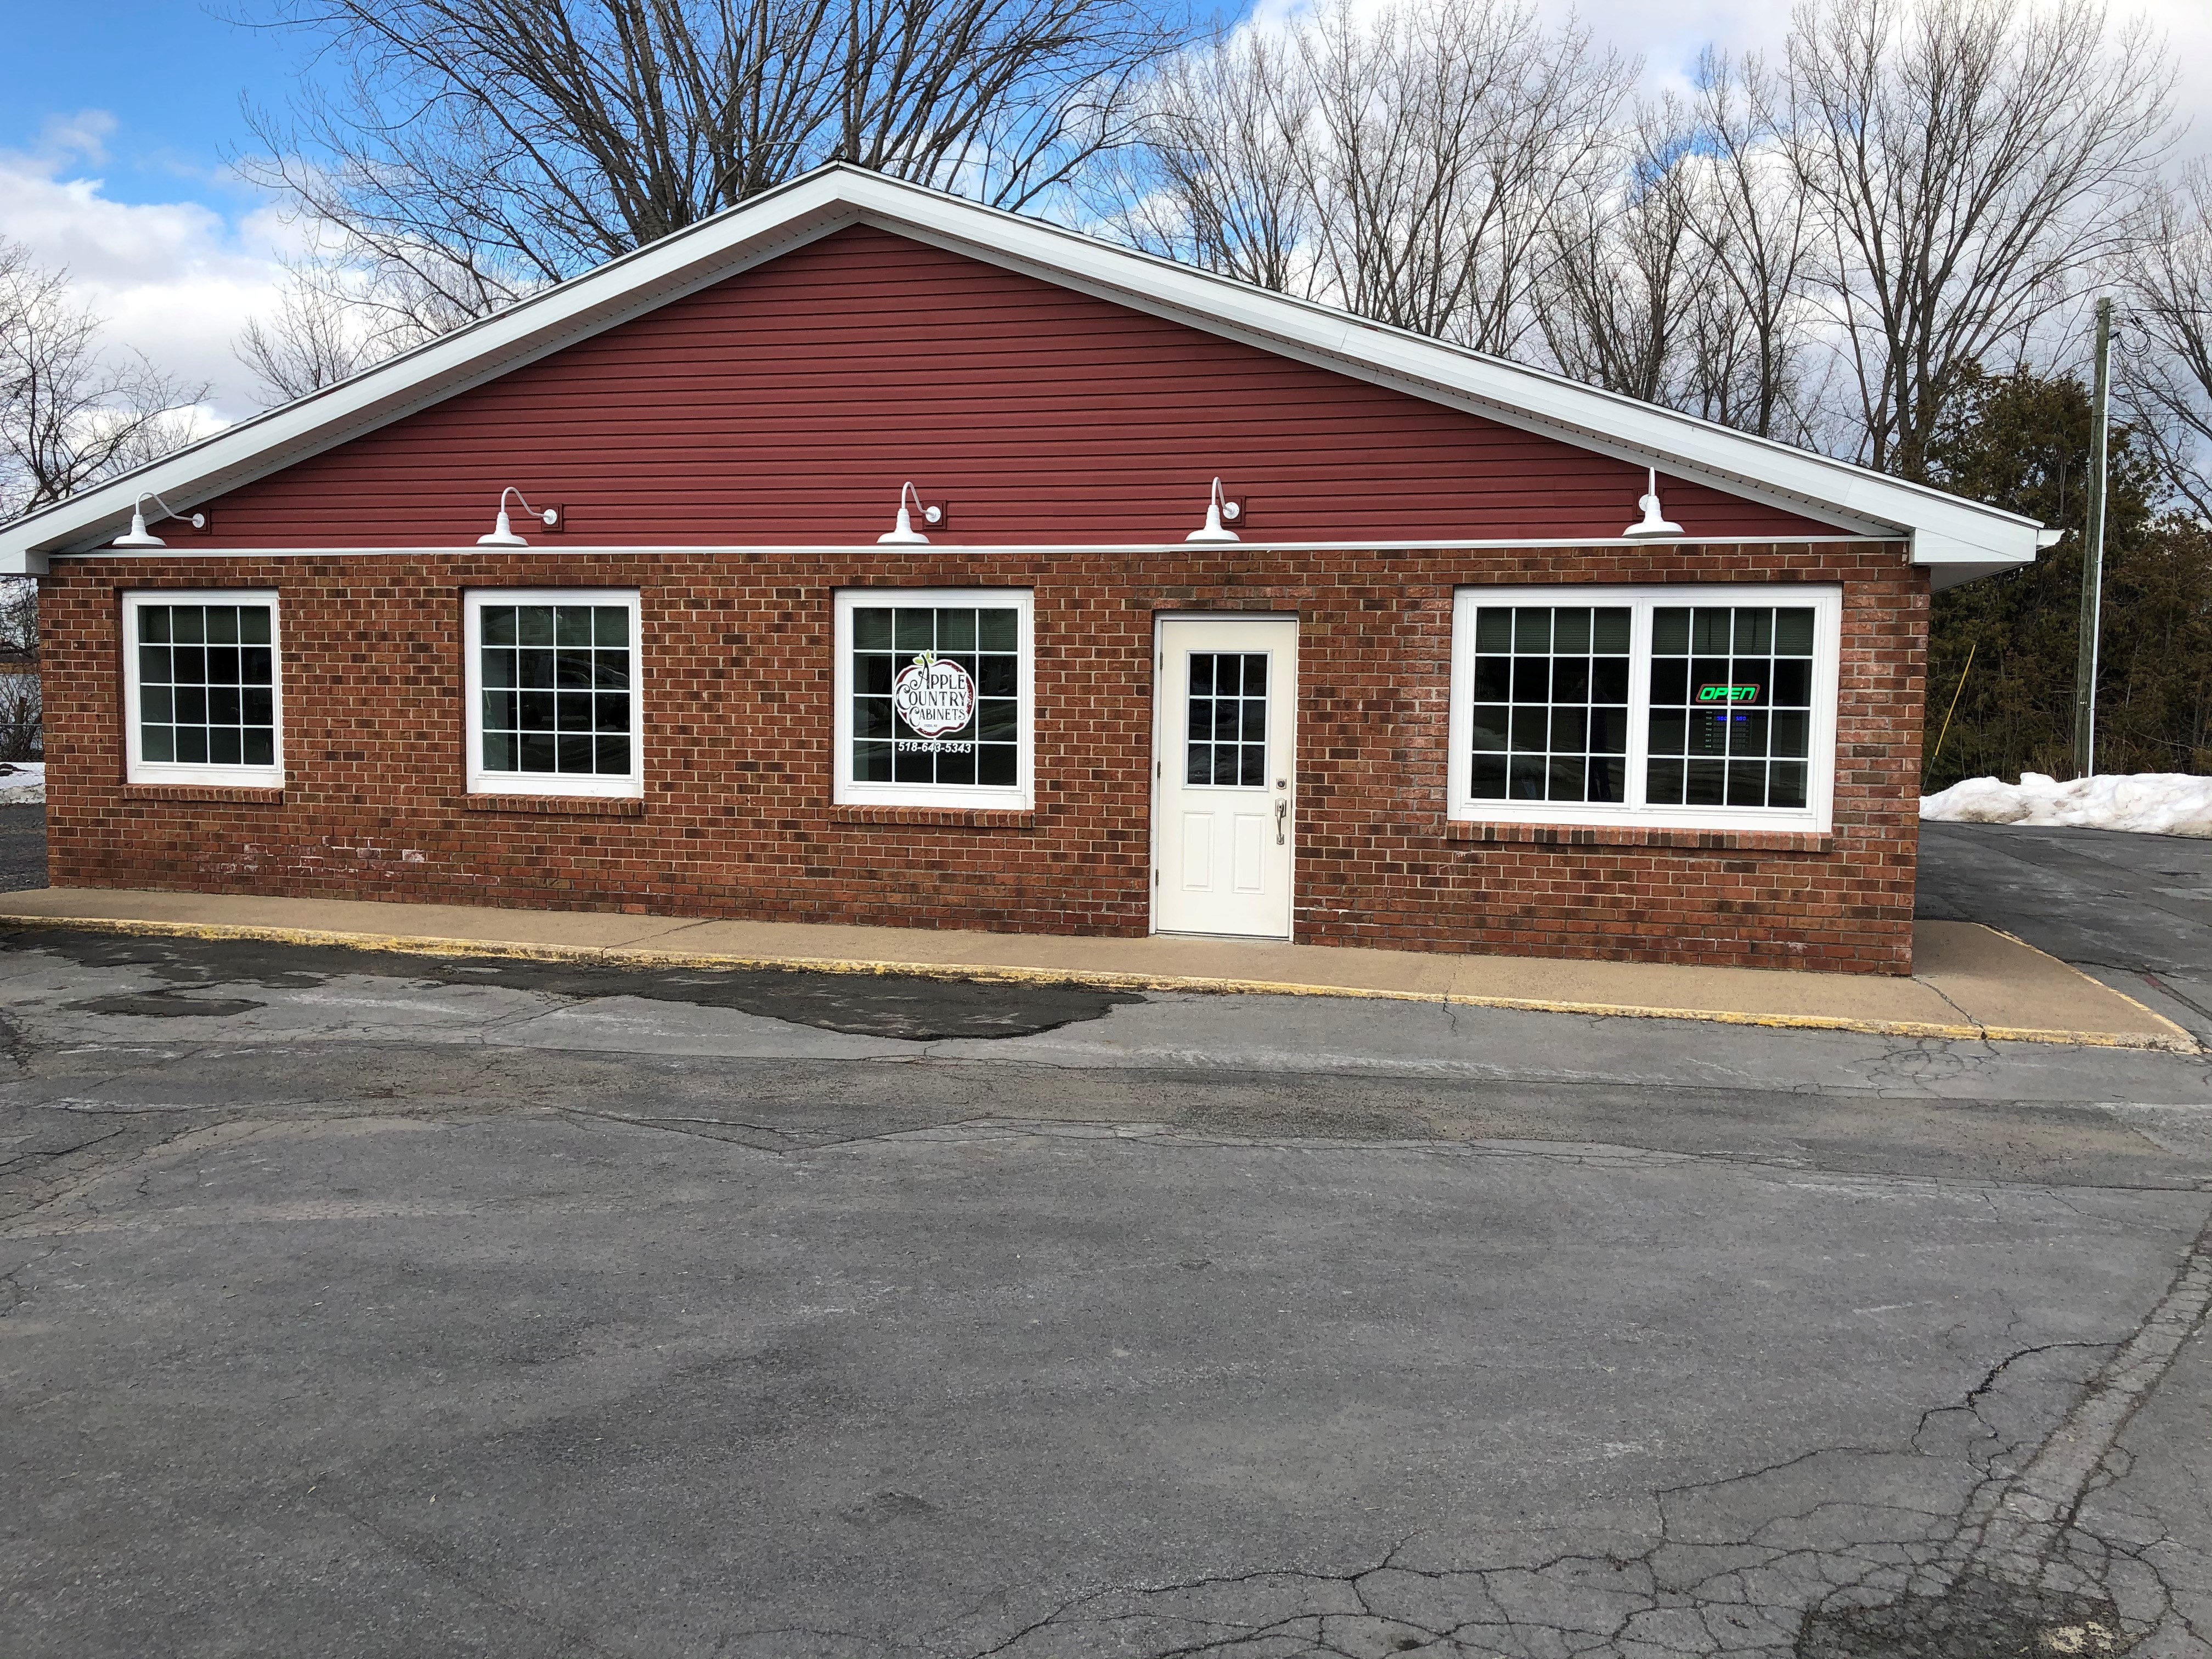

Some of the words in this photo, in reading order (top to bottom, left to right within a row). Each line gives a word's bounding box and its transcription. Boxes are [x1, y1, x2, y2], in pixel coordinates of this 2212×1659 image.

[910, 660, 965, 690] APPLE
[896, 684, 967, 710] COUNTRY
[1700, 687, 1756, 699] OPEN
[909, 707, 966, 727] CABINETS
[898, 742, 971, 753] 518-643-5343
